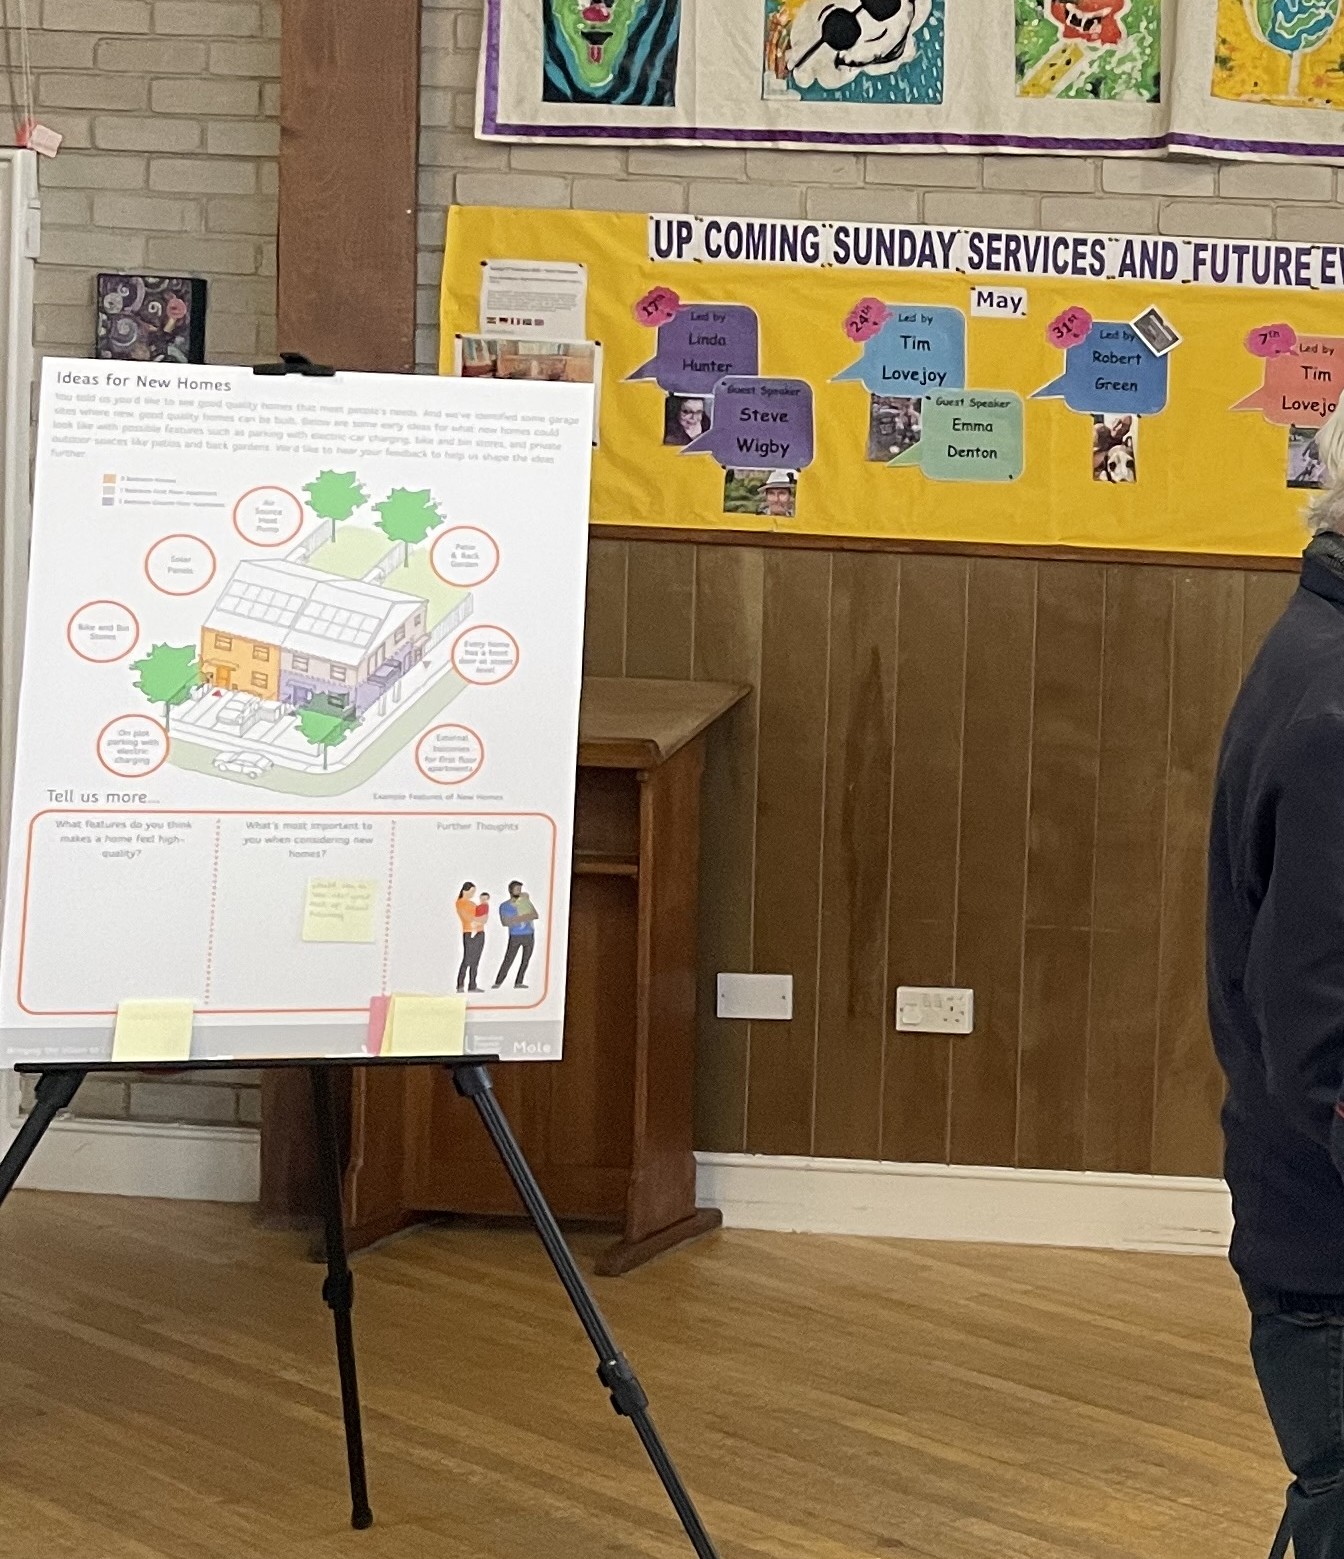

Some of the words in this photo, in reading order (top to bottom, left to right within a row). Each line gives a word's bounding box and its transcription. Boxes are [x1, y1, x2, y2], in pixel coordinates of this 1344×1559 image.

[653, 219, 693, 258] UP
[704, 221, 820, 263] COMING
[832, 225, 957, 269] SUNDAY
[968, 232, 1105, 276] SERVICES
[1118, 239, 1178, 280] AND
[1193, 243, 1312, 286] FUTURE
[976, 291, 1023, 313] May
[690, 311, 709, 322] Led
[713, 312, 726, 323] by
[898, 313, 917, 324] Led
[921, 314, 933, 326] by
[688, 333, 727, 346] Linda
[900, 335, 931, 351] Tim
[1100, 330, 1119, 340] Led
[1122, 331, 1135, 342] by
[1299, 343, 1318, 354] Led
[1322, 345, 1335, 356] by
[1092, 350, 1142, 366] Robert
[682, 359, 733, 373] Hunter
[882, 365, 947, 387] Lovejoy
[1300, 365, 1332, 382] Tim
[57, 371, 99, 385] Ideas
[106, 373, 130, 387] for
[137, 375, 171, 389] New
[177, 377, 232, 392] Homes
[1095, 377, 1138, 392] Green
[727, 385, 756, 395] Guest
[760, 386, 801, 398] Speaker
[935, 396, 965, 407] Guest
[970, 398, 1012, 409] Speaker
[1282, 395, 1337, 418] Lovejo
[739, 407, 789, 423] Steve
[952, 418, 994, 432] Emma
[736, 437, 790, 458] Wigby
[947, 445, 997, 459] Denton
[47, 789, 73, 802] Tell
[81, 793, 99, 803] us
[56, 820, 81, 828] What
[85, 820, 127, 829] features
[130, 820, 143, 829] do
[146, 822, 164, 831] you
[168, 820, 192, 829] think
[246, 821, 278, 830] What's
[283, 822, 307, 831] most
[311, 822, 358, 832] important
[437, 822, 472, 831] Further
[476, 822, 519, 832] Thoughts
[60, 834, 92, 843] makes
[105, 835, 132, 843] home
[136, 834, 155, 843] feel
[243, 837, 262, 846] you
[265, 836, 291, 844] when
[294, 836, 350, 846] considering
[101, 849, 142, 859] quality?
[289, 850, 327, 858] homes?
[513, 1040, 551, 1055] Mole
